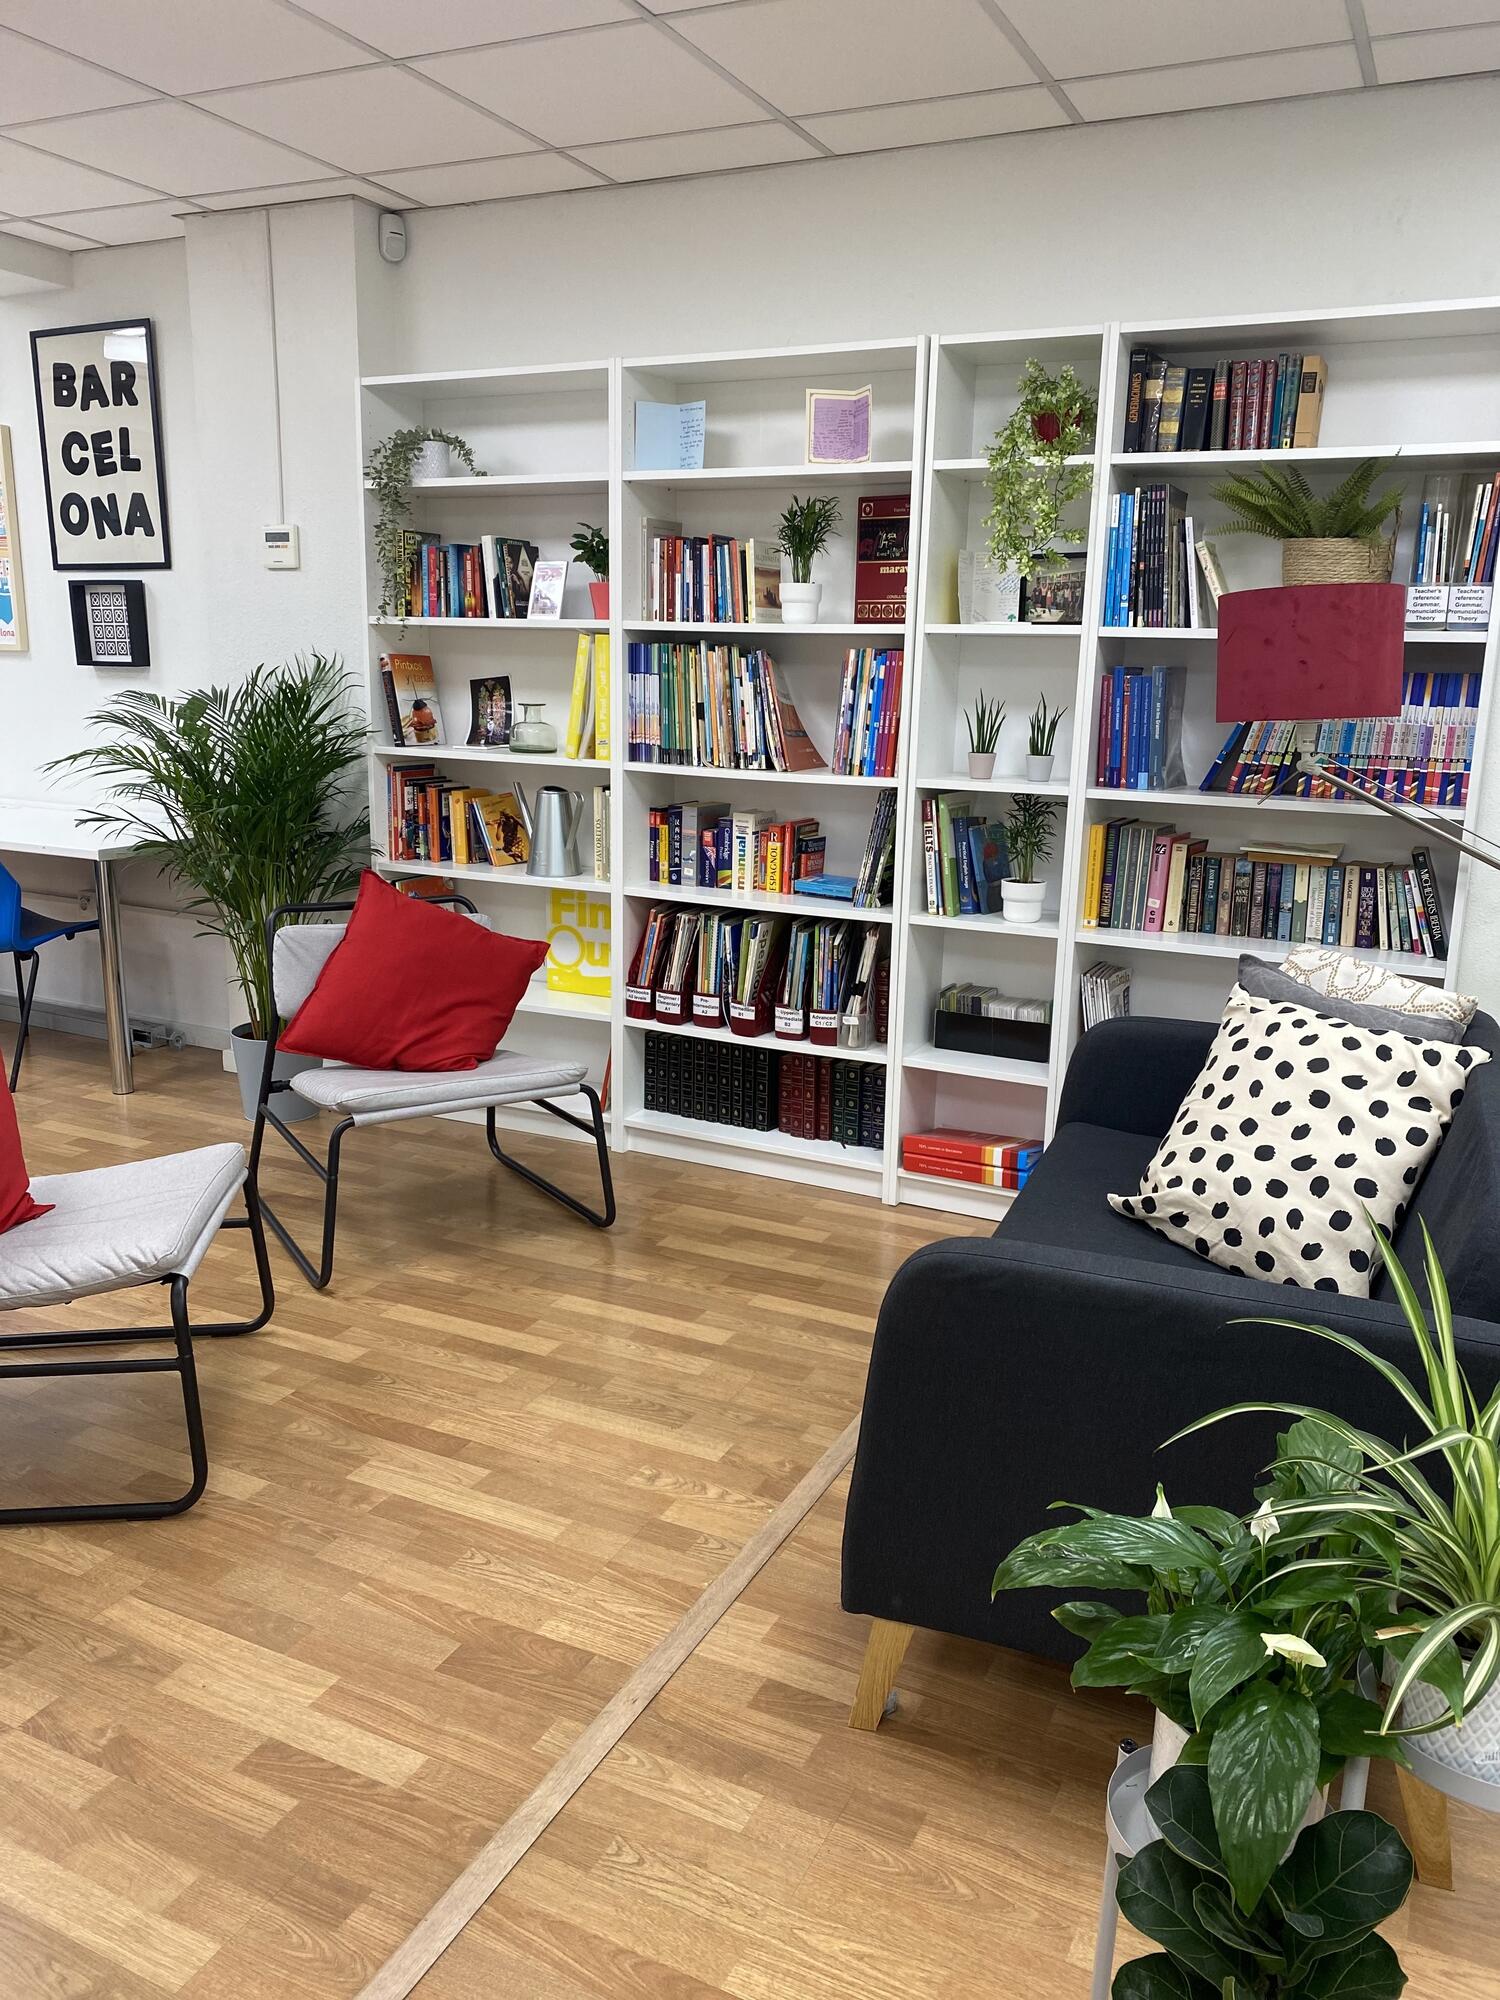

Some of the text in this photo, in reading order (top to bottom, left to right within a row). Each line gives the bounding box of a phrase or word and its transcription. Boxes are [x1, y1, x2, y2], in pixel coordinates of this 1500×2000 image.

[52, 361, 138, 411] BAR
[61, 427, 141, 477] CEL
[59, 492, 155, 540] ONA
[723, 827, 731, 860] Cambridge
[924, 825, 934, 853] IELTS
[736, 835, 747, 890] manual
[769, 846, 778, 891] ESPAGNOL
[1100, 883, 1112, 917] DECEPTION
[1346, 879, 1354, 900] MAGGIE
[1428, 914, 1442, 940] IBERIA
[657, 999, 680, 1007] Elementary
